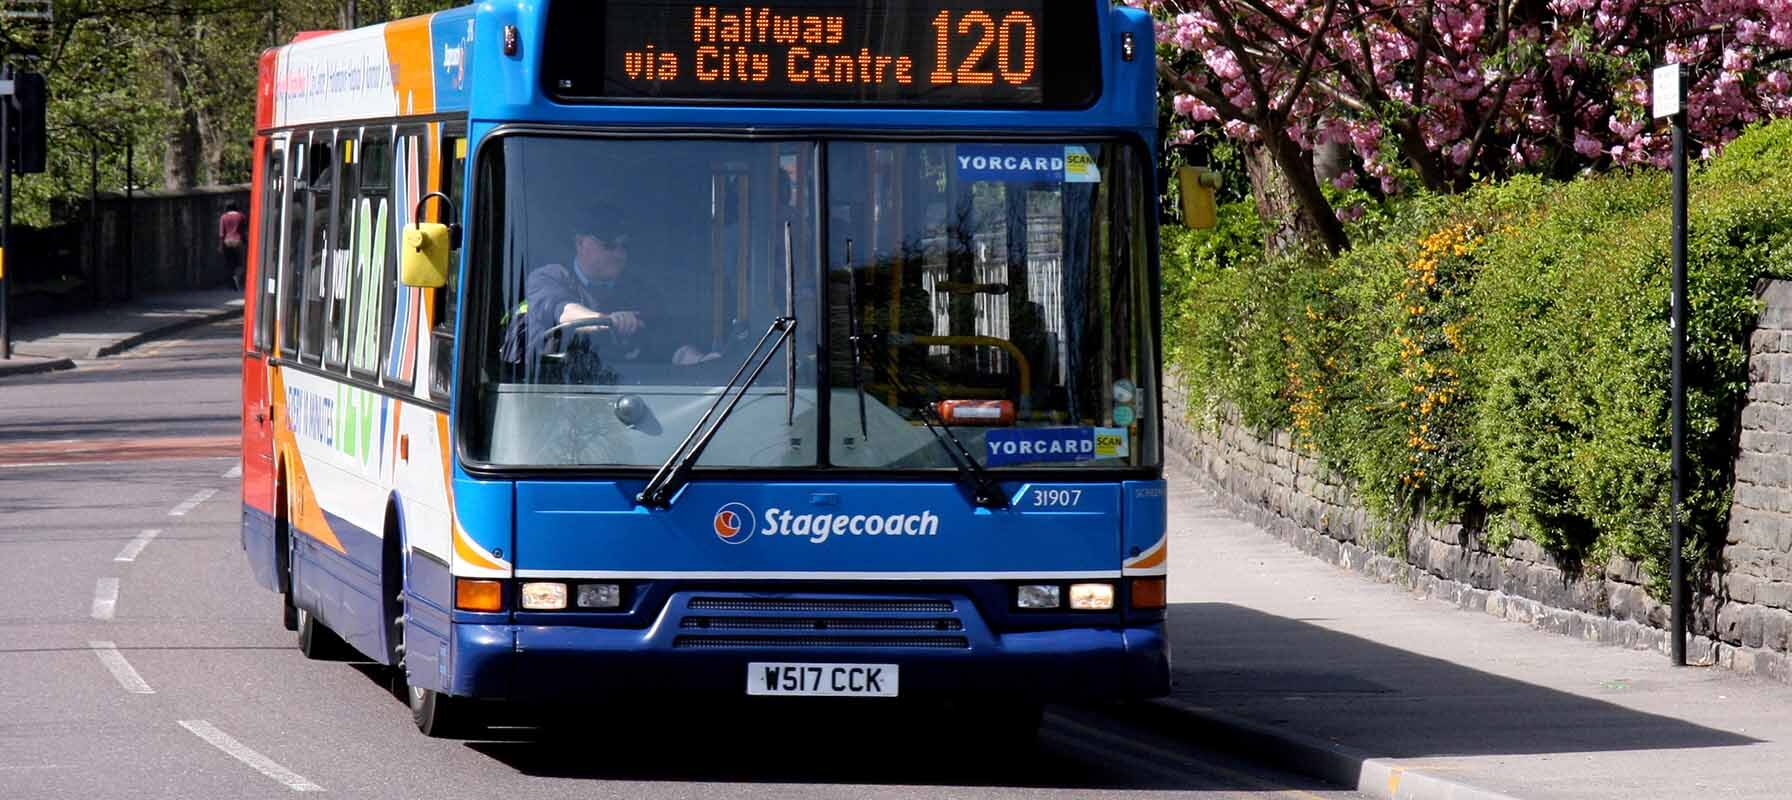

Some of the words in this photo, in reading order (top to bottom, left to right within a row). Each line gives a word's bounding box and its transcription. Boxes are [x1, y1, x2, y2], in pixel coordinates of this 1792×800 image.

[693, 7, 843, 44] Halfway
[930, 9, 1036, 85] 120
[624, 45, 677, 81] via
[696, 45, 769, 82] City
[786, 46, 912, 84] Centre
[958, 156, 1063, 171] YORCARD
[989, 439, 1093, 454] YORCARD
[1096, 434, 1122, 446] SCAN
[1033, 489, 1081, 506] 31907
[761, 507, 939, 544] Stagecoach
[764, 666, 822, 691] W517
[831, 667, 882, 692] CCK
